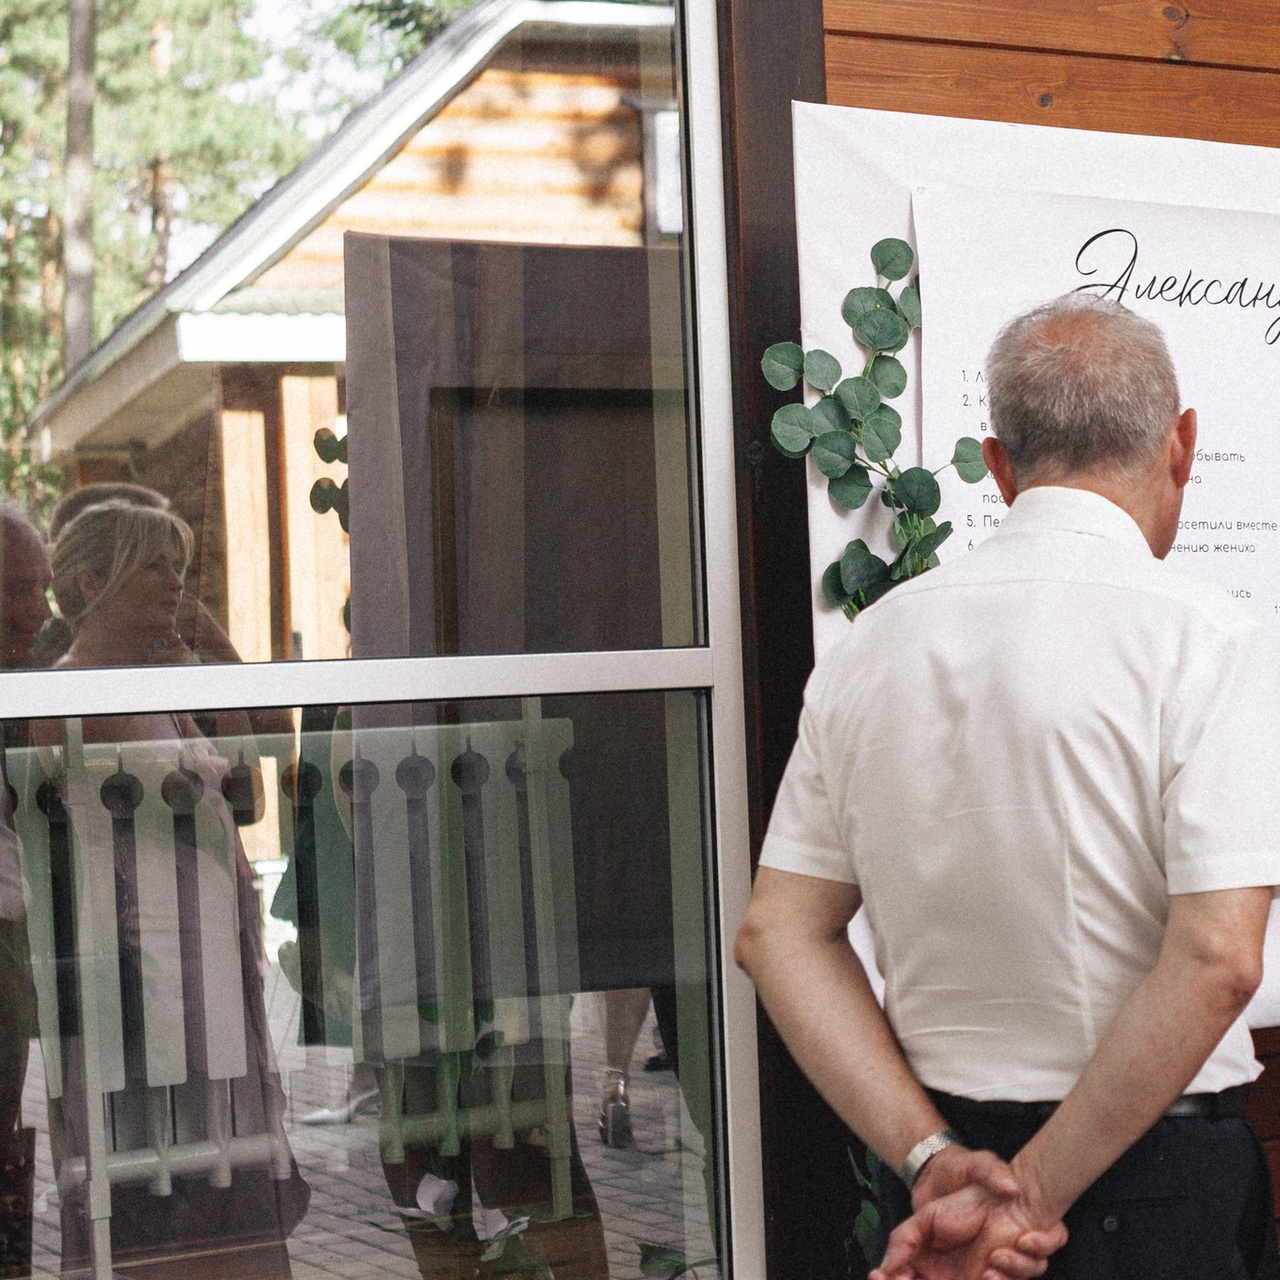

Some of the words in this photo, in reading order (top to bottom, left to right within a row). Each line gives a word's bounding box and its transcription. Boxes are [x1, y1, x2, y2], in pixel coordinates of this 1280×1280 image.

[962, 393, 972, 407] 2.
[966, 514, 977, 528] 5.
[1177, 521, 1233, 531] осетили
[1236, 521, 1278, 531] вместе
[1170, 543, 1210, 553] нению
[1213, 543, 1256, 553] жениха
